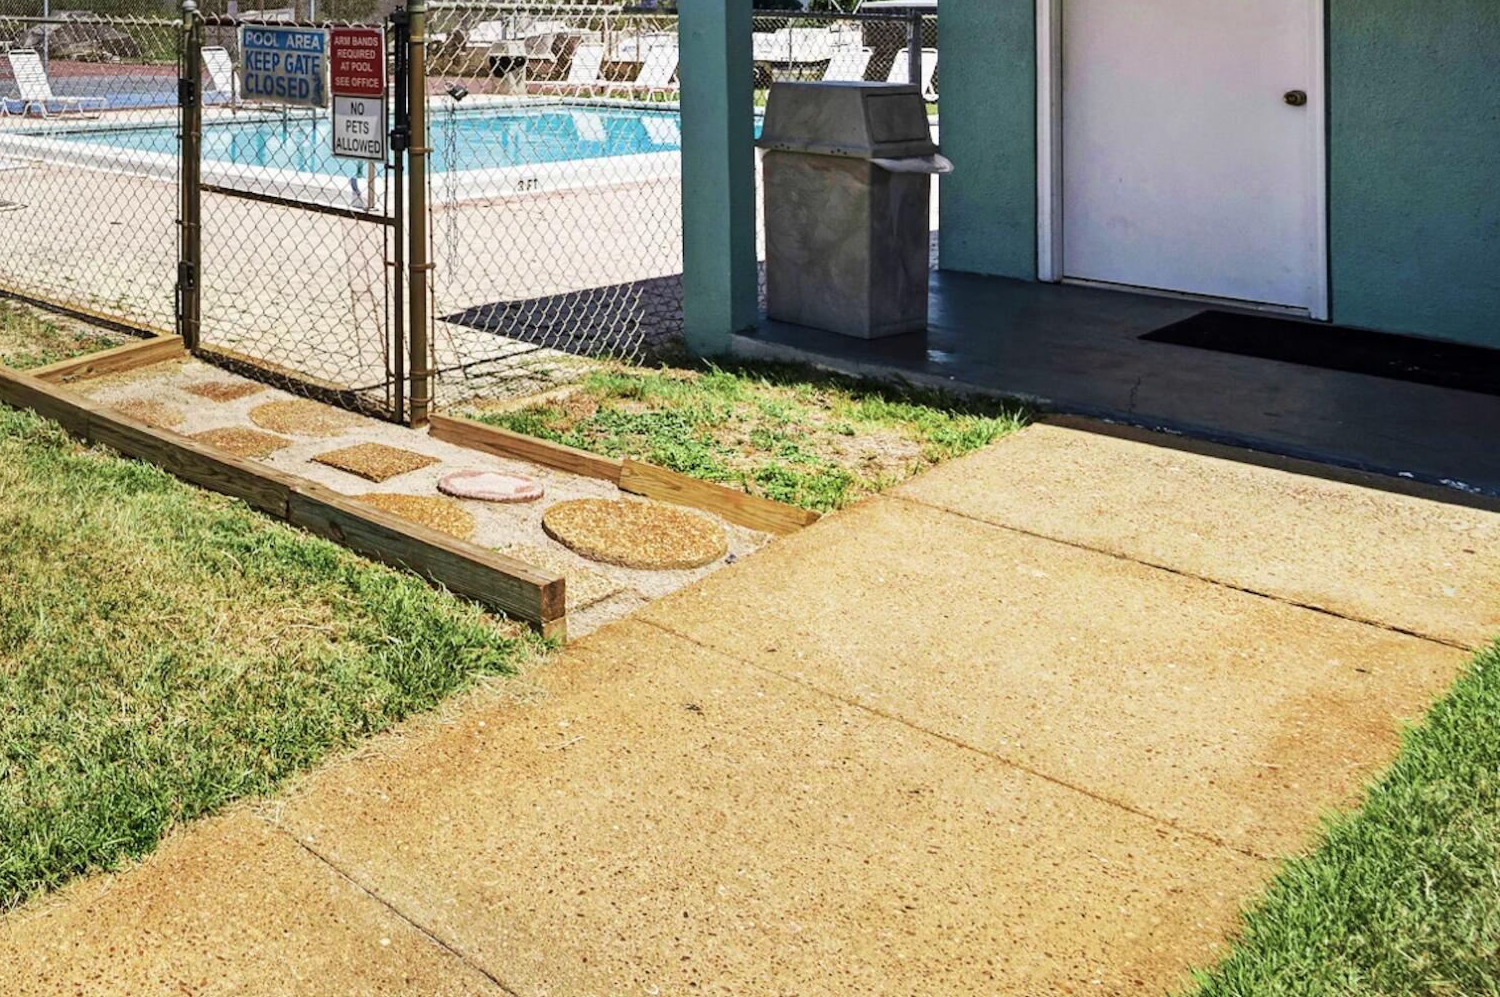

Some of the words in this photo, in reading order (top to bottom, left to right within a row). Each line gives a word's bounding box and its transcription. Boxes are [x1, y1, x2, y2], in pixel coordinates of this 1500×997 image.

[245, 31, 279, 46] POOL
[286, 34, 321, 50] AREA
[334, 36, 351, 46] ARM
[352, 36, 378, 46] BANDS
[337, 49, 376, 60] REQUIRED
[245, 50, 280, 72] KEEP
[285, 53, 320, 75] GATE
[340, 61, 350, 71] AT
[351, 61, 373, 72] POOL
[245, 73, 310, 99] CLOSED
[335, 77, 350, 87] SEE
[352, 77, 379, 88] OFFICE
[350, 102, 364, 115] NO
[346, 120, 369, 135] PETS
[336, 136, 381, 154] ALLOWED
